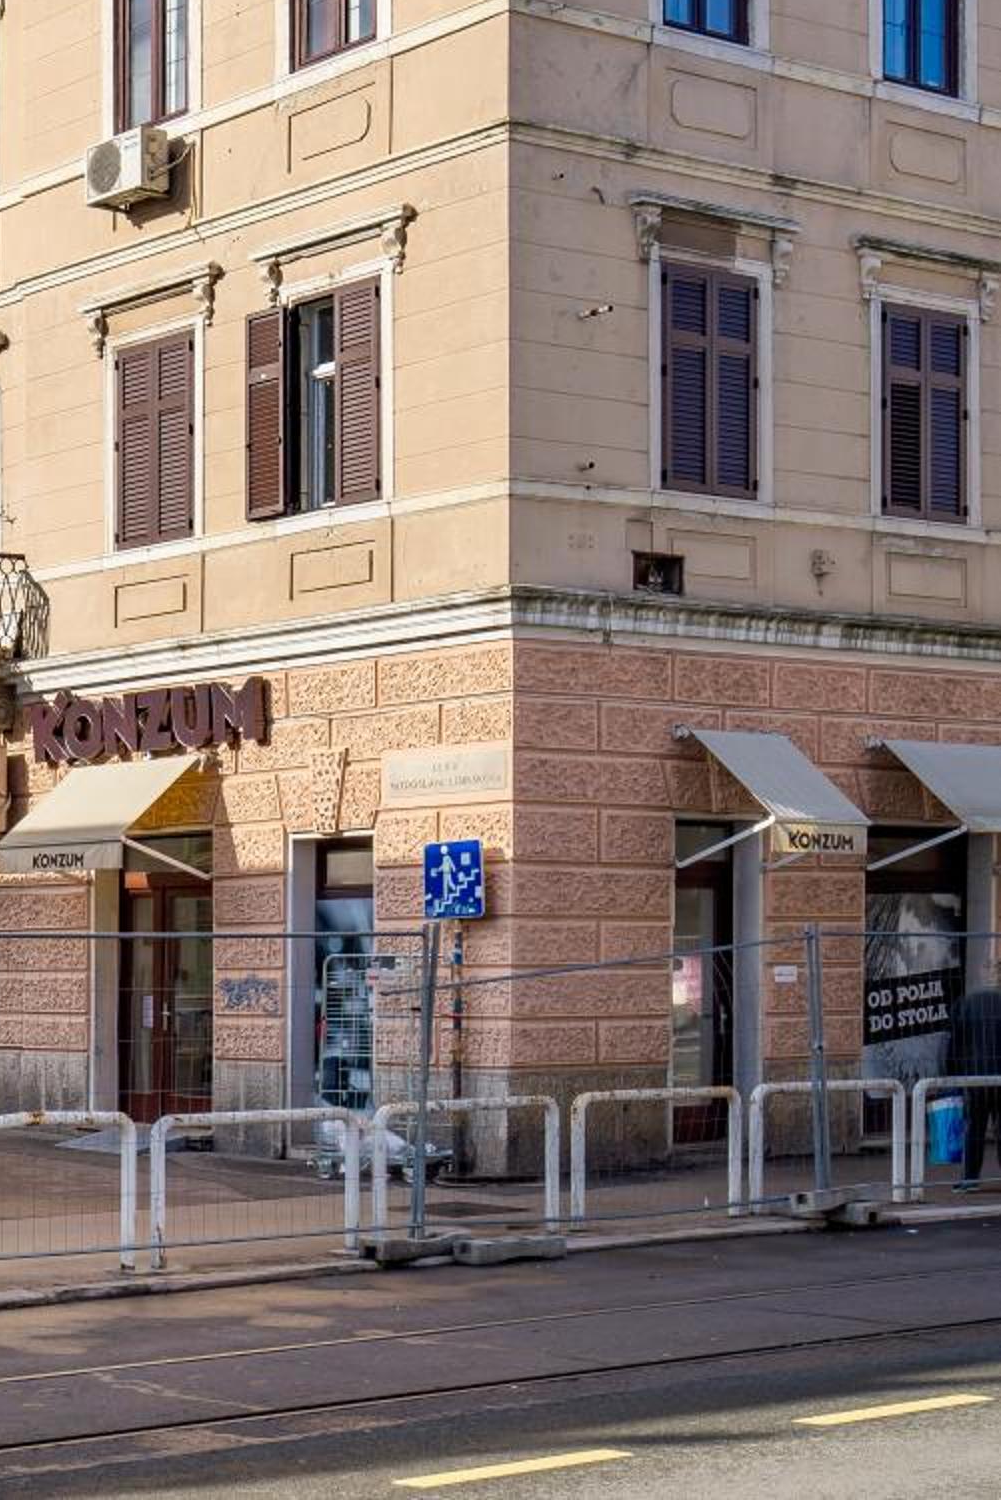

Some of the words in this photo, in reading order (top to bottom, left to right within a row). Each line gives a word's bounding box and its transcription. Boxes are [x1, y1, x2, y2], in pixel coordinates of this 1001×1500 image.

[31, 677, 271, 763] KONZUM
[788, 828, 854, 851] KONZUM
[32, 853, 84, 868] KONZUM
[868, 989, 893, 1008] OD
[869, 1014, 894, 1032] DO
[898, 1003, 949, 1027] STOLA
